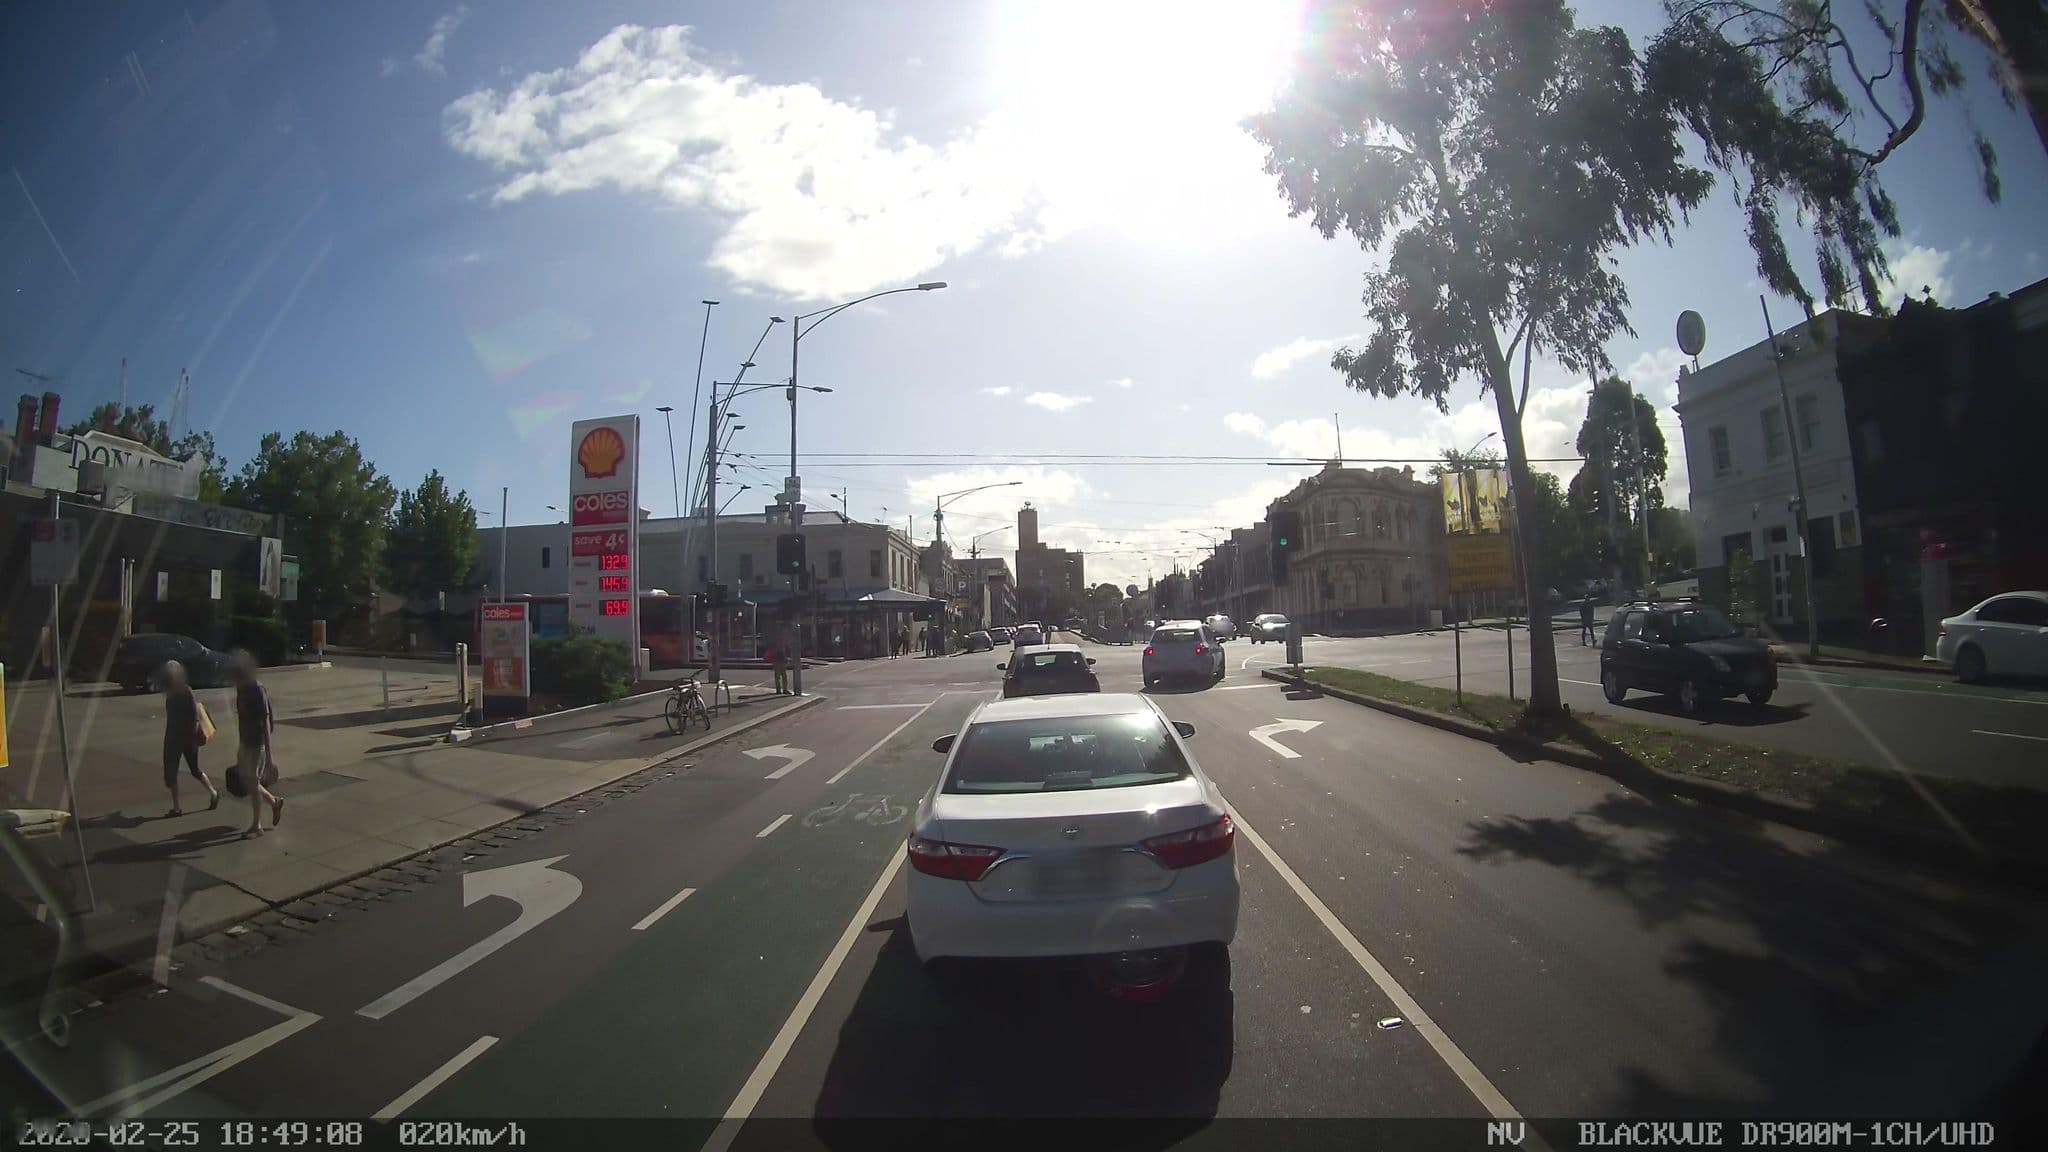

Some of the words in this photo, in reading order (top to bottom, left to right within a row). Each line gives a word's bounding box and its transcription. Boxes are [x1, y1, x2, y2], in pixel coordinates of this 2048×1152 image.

[575, 490, 628, 512] coles
[574, 534, 602, 546] save
[484, 605, 511, 619] coles
